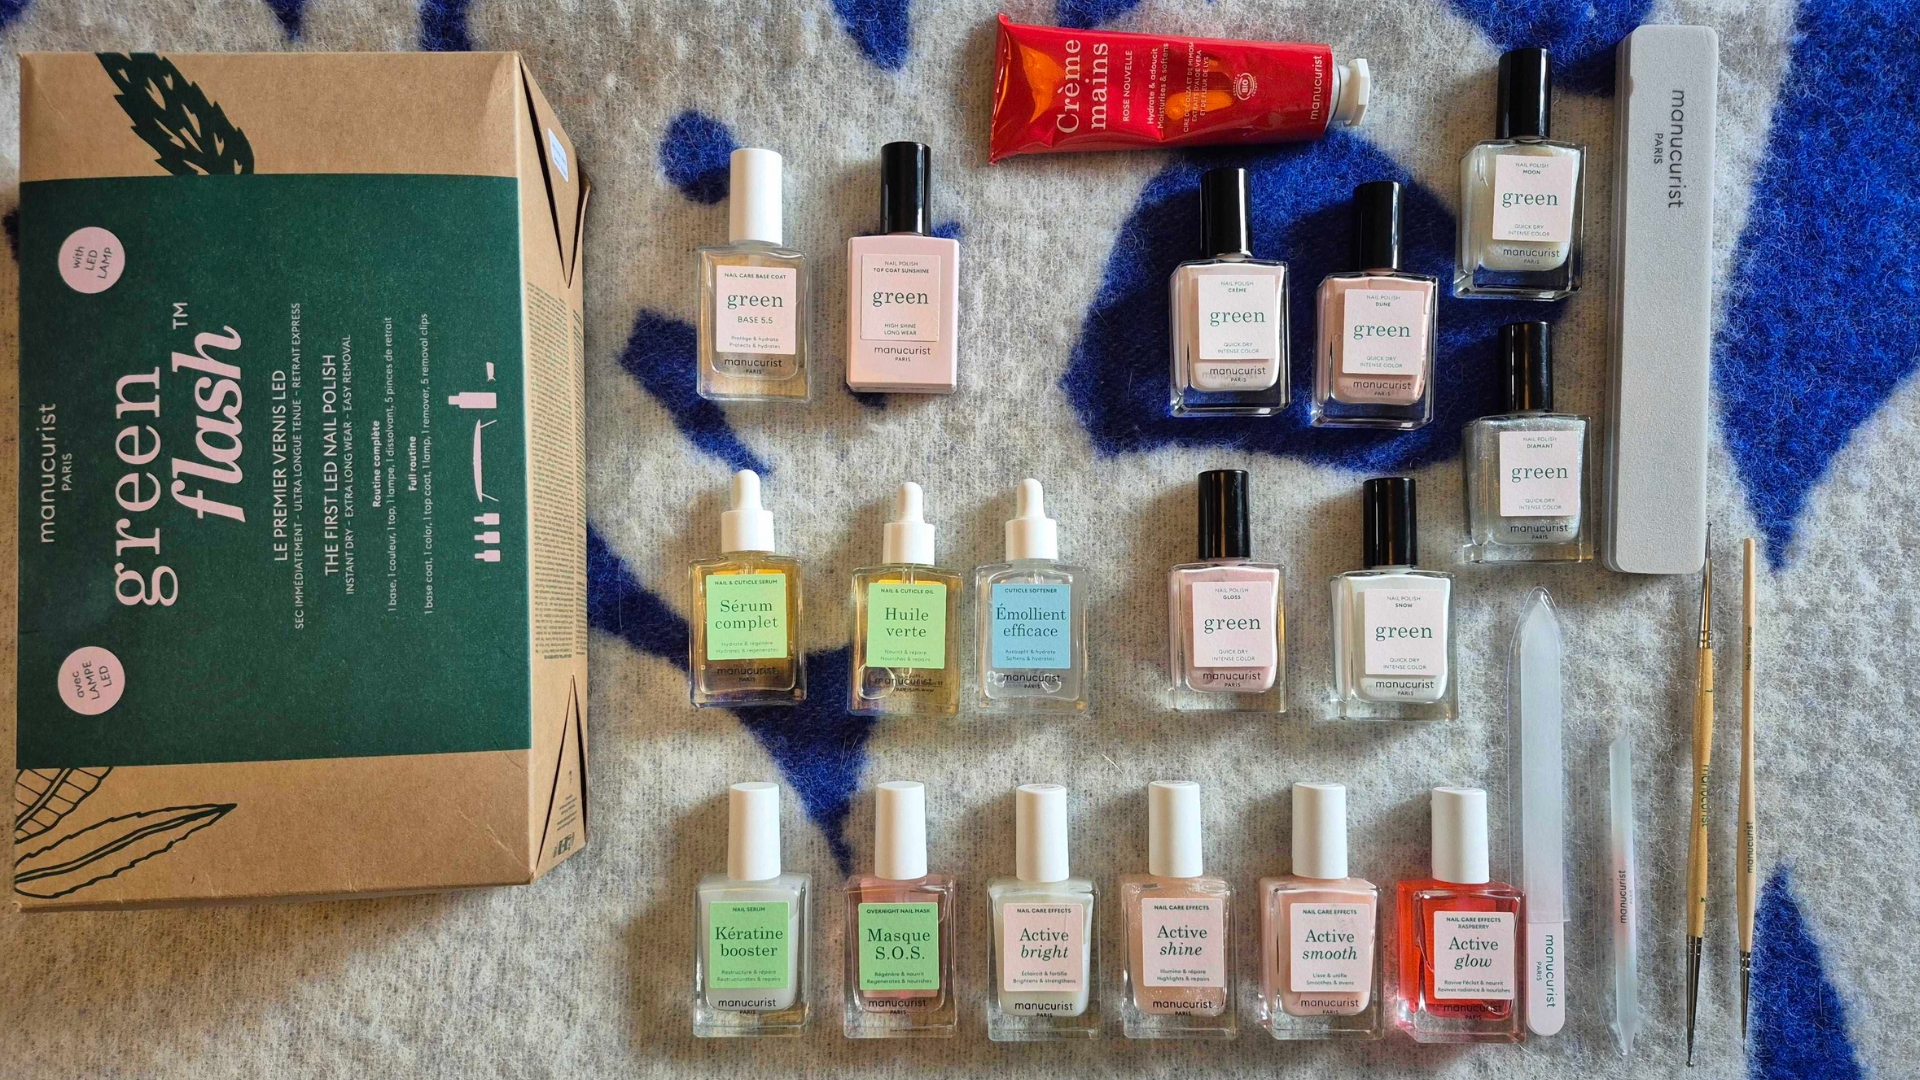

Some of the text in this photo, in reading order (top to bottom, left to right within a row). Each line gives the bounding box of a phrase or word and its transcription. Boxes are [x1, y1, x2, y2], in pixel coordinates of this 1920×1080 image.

[1123, 50, 1132, 97] NOUVELLE
[1056, 40, 1080, 134] Crème
[1085, 43, 1108, 130] mains
[1147, 48, 1158, 124] Hydrate adoucit
[1158, 43, 1168, 128] Moisturises softens
[1310, 56, 1322, 120] manucurist
[1654, 133, 1663, 164] PARIS
[1668, 90, 1686, 208] manucurist
[1502, 193, 1558, 208] green
[72, 246, 84, 269] with
[84, 249, 98, 271] LED
[1503, 248, 1560, 257] manucurist
[98, 246, 113, 279] LAMP
[727, 295, 783, 309] green
[873, 292, 928, 307] green
[1210, 311, 1265, 327] green
[1354, 325, 1410, 340] green
[874, 346, 931, 355] manucurist
[724, 358, 782, 367] manucurist
[1210, 366, 1266, 375] manucurist
[1353, 381, 1411, 390] manucurist
[170, 326, 246, 522] flash
[272, 370, 288, 560] LE PREMIER VERNIS LED
[291, 303, 304, 629] SEC IMMÉDIATEMENT ULTRA LONGUE TENUE RETRAIT EXPRESS
[322, 355, 339, 576] THE FIRST LED NAIL POLISH
[342, 335, 355, 594] INSTANT DRY EXTRA LONG WEAR EASY REMOVAL
[371, 420, 382, 507] Routine complète
[384, 317, 397, 605] base, couleur, top, lampe, dissolvant, pinces retrait
[408, 436, 417, 491] Full routine
[420, 314, 433, 608] base coat, color, top coat, lamp, remover, removal clips
[37, 404, 56, 543] manucurist
[61, 452, 73, 491] PARIS
[1512, 468, 1568, 483] green
[114, 366, 179, 607] green
[1511, 523, 1568, 532] manucurist
[720, 600, 772, 612] Sérum
[886, 607, 929, 621] Huile
[996, 603, 1066, 620] Émollient
[716, 615, 778, 631] complet
[1004, 624, 1058, 637] efficace
[1204, 619, 1261, 634] green
[886, 626, 927, 637] verte
[1376, 626, 1433, 642] green
[82, 660, 100, 700] LAMPE
[98, 665, 112, 687] LED
[1203, 671, 1261, 680] manucurist
[72, 670, 86, 698] avec
[1376, 680, 1434, 688] manucurist
[1745, 821, 1754, 874] manucurist
[1618, 870, 1628, 924] manucurist
[716, 927, 783, 940] Kératine
[868, 928, 930, 944] Masque
[1019, 928, 1069, 941] Active
[1158, 925, 1207, 938] Active
[1305, 929, 1354, 942] Active
[720, 944, 778, 956] booster
[1160, 942, 1202, 955] shine
[1449, 936, 1498, 950] Active
[876, 946, 925, 960] S.O.S.
[1021, 945, 1068, 961] bright
[1302, 947, 1357, 960] smooth
[1454, 954, 1492, 970] glow
[1546, 935, 1557, 1008] manucurist
[718, 998, 776, 1007] manucurist
[869, 998, 926, 1007] manucurist
[1014, 1001, 1073, 1010] manucurist
[1153, 999, 1212, 1008] manucurist
[1301, 998, 1359, 1007] manucurist
